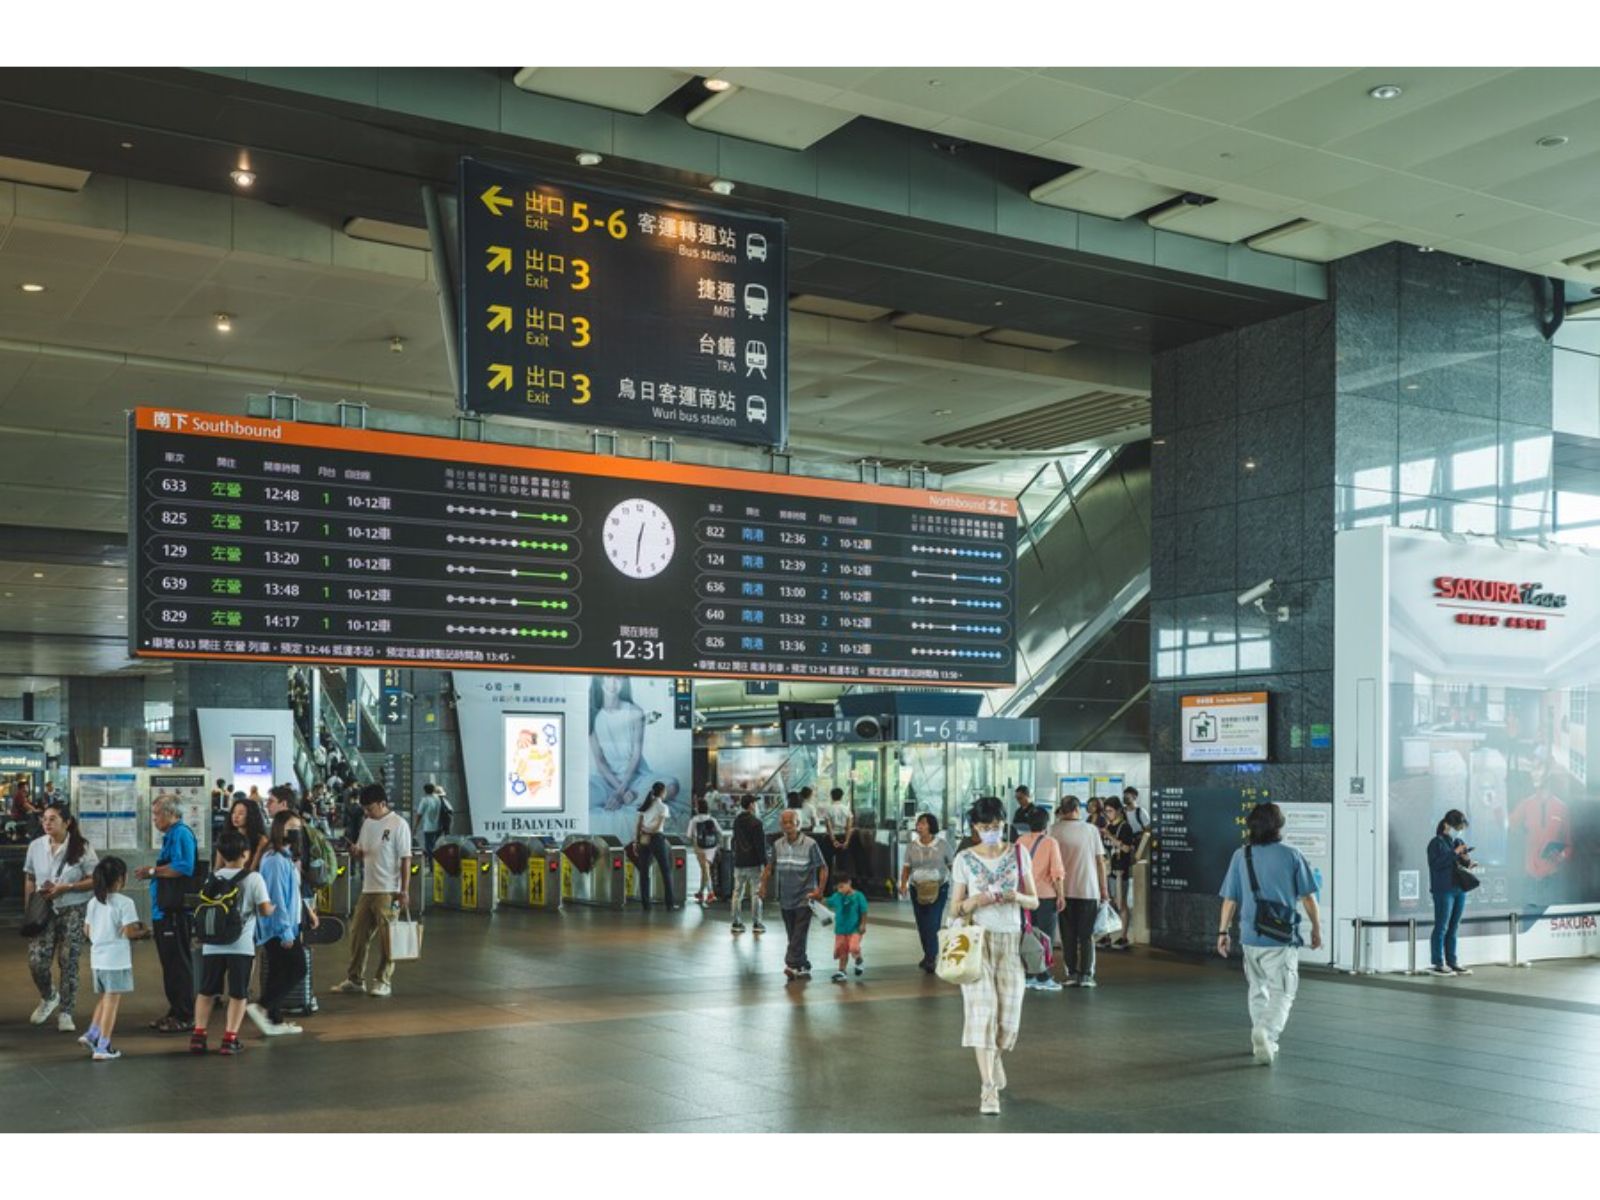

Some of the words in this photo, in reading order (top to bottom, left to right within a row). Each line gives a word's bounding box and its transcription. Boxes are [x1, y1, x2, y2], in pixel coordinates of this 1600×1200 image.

[526, 191, 565, 216] 出口
[572, 202, 627, 239] 5-6
[526, 215, 549, 231] Exit
[637, 211, 737, 249] 客運轉運站
[678, 244, 700, 259] Bus
[701, 247, 738, 265] station
[525, 249, 565, 275] 出口
[571, 260, 590, 290] 3
[526, 274, 549, 289] Exit
[697, 277, 735, 303] 捷運
[713, 305, 735, 317] MRT
[526, 307, 565, 333] 出口
[572, 317, 590, 347] 3
[525, 331, 549, 347] Exit
[700, 333, 736, 358] 台鐵
[716, 360, 736, 372] TRA
[526, 365, 565, 389] 出口
[572, 374, 591, 404] 3
[527, 390, 550, 404] Exit
[154, 411, 189, 429] 南下
[192, 417, 283, 440] Southbound
[679, 410, 699, 422] bus
[701, 414, 736, 427] station
[162, 479, 187, 492] 633
[265, 488, 299, 501] 12:48
[323, 493, 329, 504] 1
[162, 511, 187, 524] 825
[265, 520, 299, 533] 13:17
[323, 524, 329, 535] 1
[706, 526, 724, 538] 822
[780, 532, 806, 544] 12:36
[822, 536, 828, 546] 2
[163, 544, 187, 557] 129
[265, 552, 299, 565] 13:20
[323, 555, 329, 566] 1
[707, 554, 724, 565] 124
[780, 559, 806, 571] 12:39
[822, 562, 828, 573] 2
[162, 577, 187, 590] 639
[265, 583, 299, 596] 13:48
[323, 587, 329, 598] 1
[706, 581, 725, 592] 636
[780, 586, 806, 597] 13:00
[821, 589, 828, 600] 2
[1433, 577, 1523, 604] SAKURA
[162, 610, 187, 622] 829
[265, 615, 299, 627] 14:17
[323, 618, 329, 629] 1
[706, 609, 724, 620] 640
[780, 613, 805, 625] 13:32
[821, 616, 827, 626] 2
[613, 640, 664, 660] 12:31
[706, 637, 725, 647] 826
[780, 640, 806, 651] 13:36
[821, 642, 828, 653] 2
[389, 694, 398, 707] 2
[810, 722, 833, 740] 1-6
[913, 719, 950, 739] 1-6
[484, 821, 509, 831] THE
[1550, 914, 1598, 931] SAKURA
